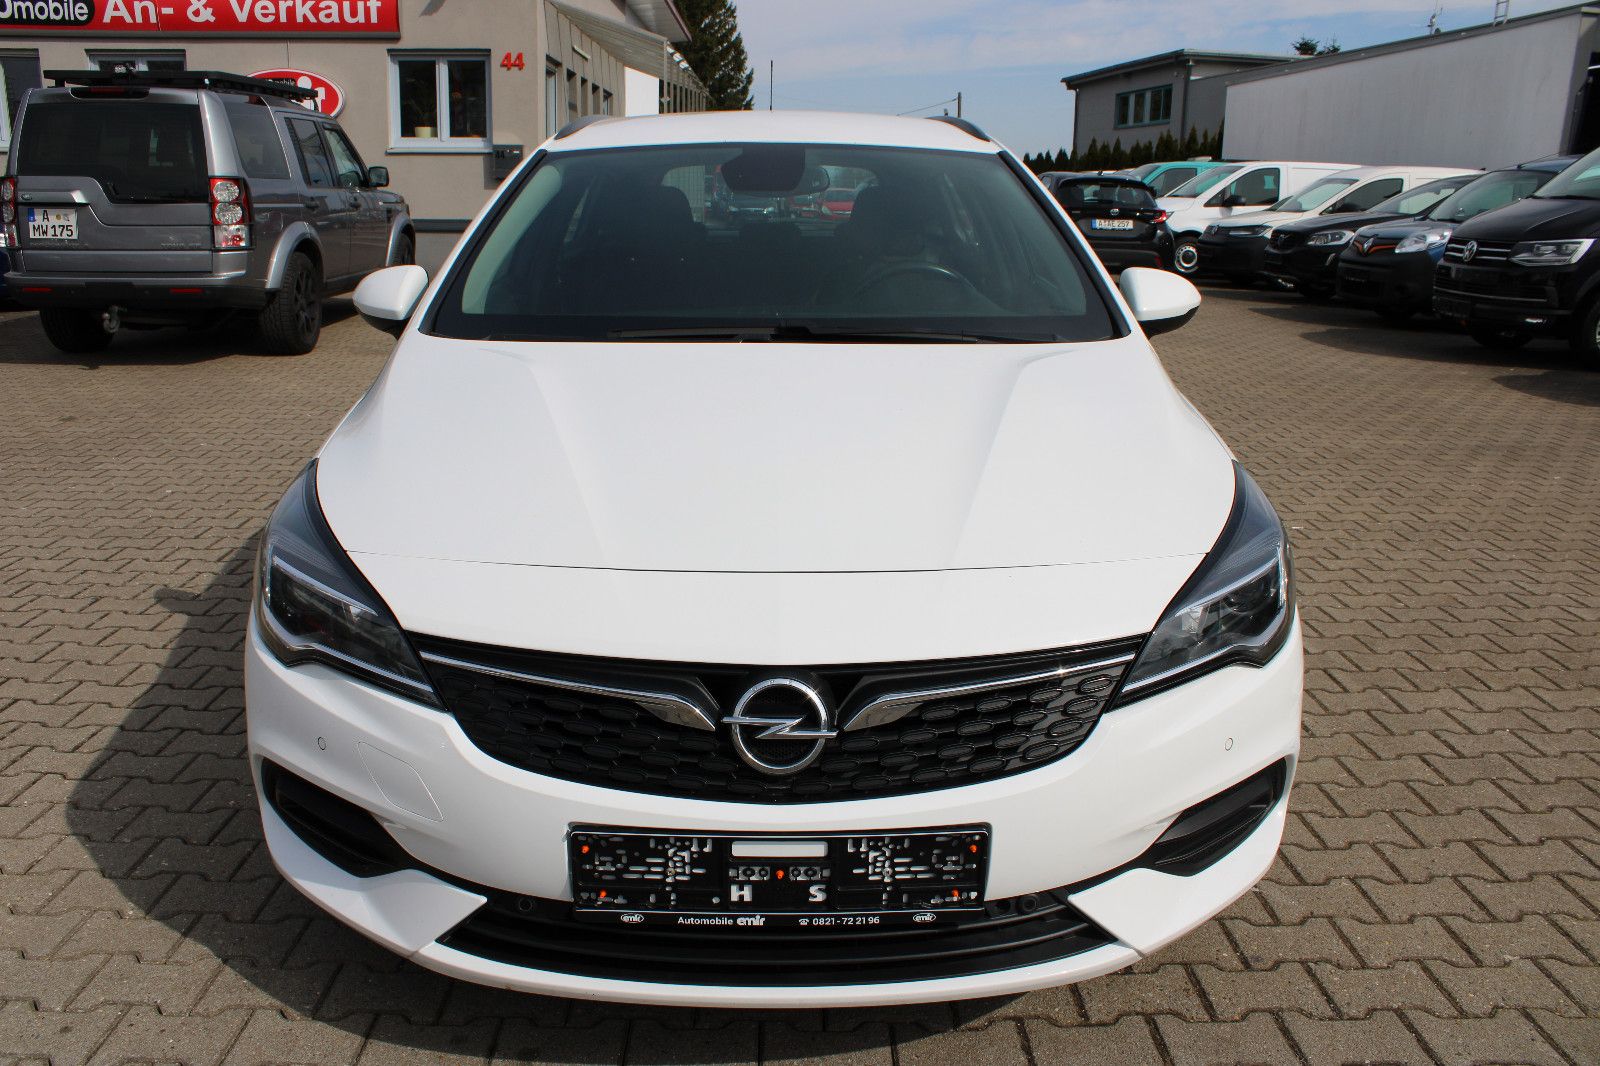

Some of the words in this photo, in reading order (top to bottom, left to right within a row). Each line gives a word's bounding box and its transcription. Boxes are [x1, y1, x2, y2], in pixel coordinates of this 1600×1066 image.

[186, 0, 216, 23] &
[229, 0, 382, 24] Verkauf
[500, 51, 526, 71] 44
[42, 209, 50, 223] A
[32, 224, 49, 237] MW
[51, 224, 74, 238] 175
[677, 915, 734, 926] Automobile
[736, 914, 766, 926] emir
